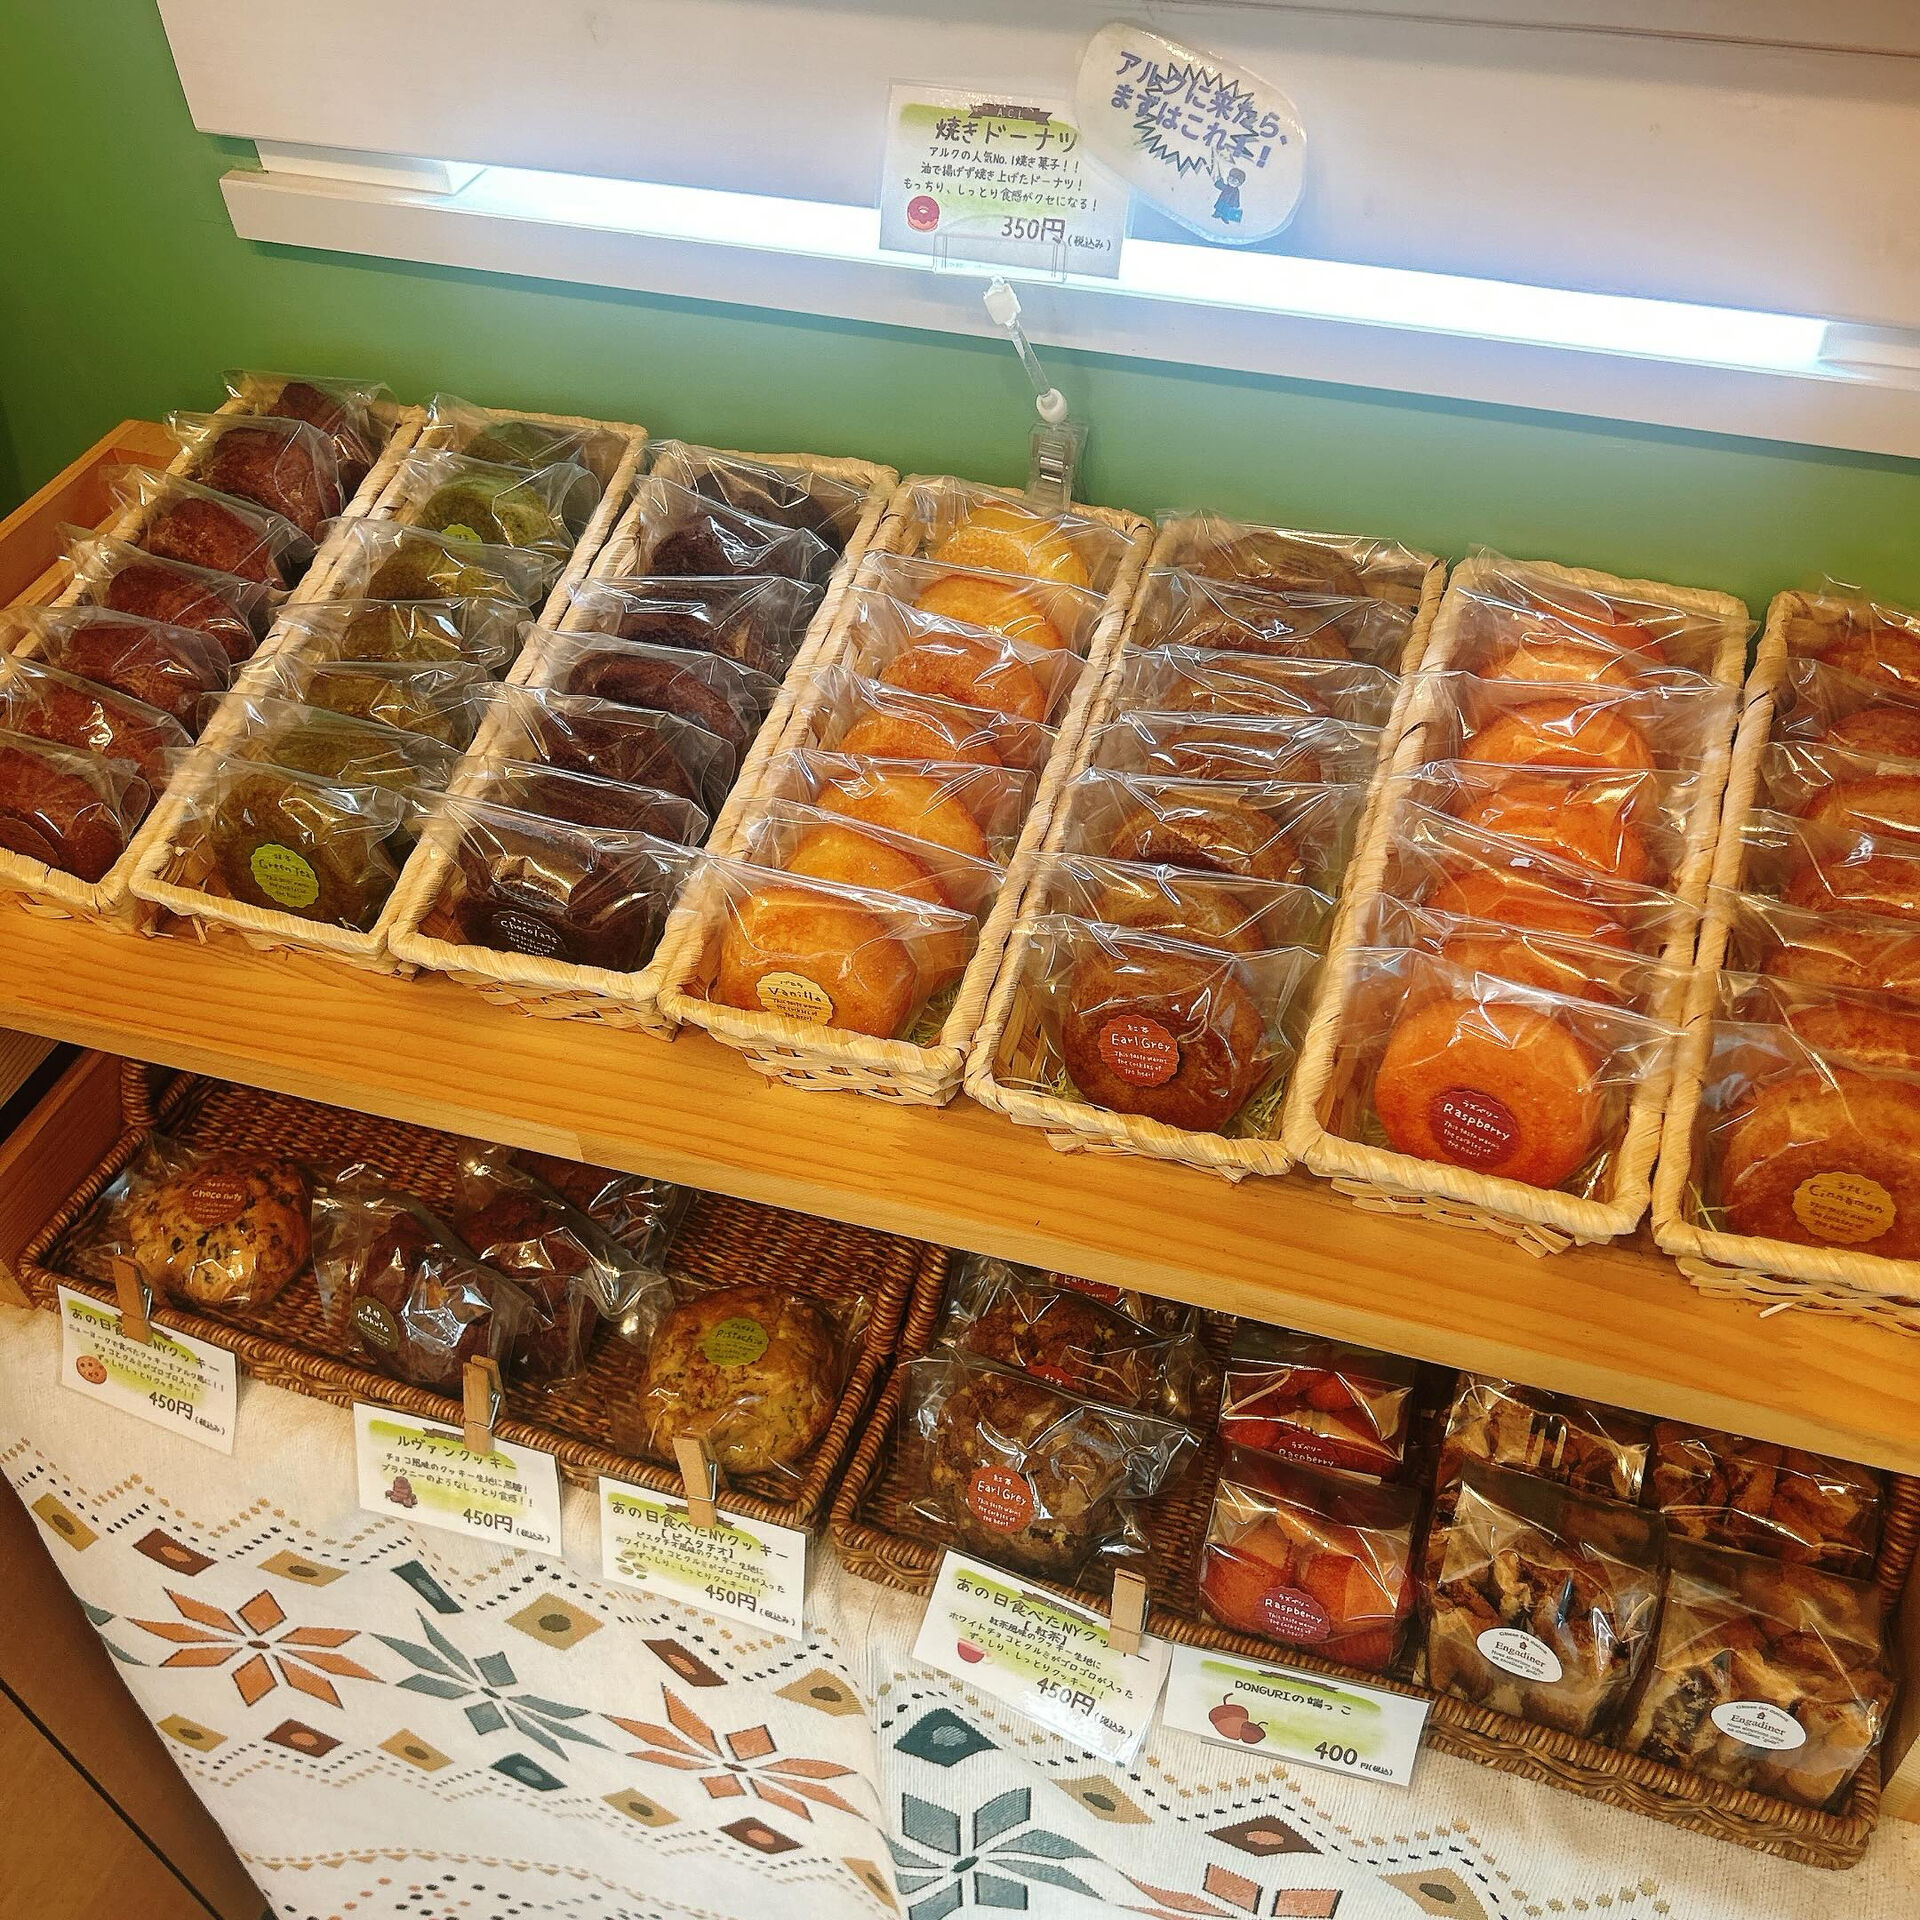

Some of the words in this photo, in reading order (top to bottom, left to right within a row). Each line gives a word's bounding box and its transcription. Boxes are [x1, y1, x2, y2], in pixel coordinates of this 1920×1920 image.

[935, 116, 1078, 153] 焼きドーナツ
[920, 163, 1083, 191] 油で揚げず焼き上げたドーナツ！
[904, 177, 1098, 212] もっちり、しっとり食感がクセになる！
[1001, 216, 1066, 244] 350円
[767, 986, 822, 1002] Vanilla
[1111, 1033, 1138, 1046] Earl
[1141, 1037, 1171, 1053] Grey
[1443, 1103, 1510, 1141] Raspberry
[1808, 1184, 1885, 1214] Cinnamon
[71, 1308, 219, 1372] あの日食NYクッキー
[148, 1391, 193, 1420] 450円
[398, 1435, 517, 1470] ルヴァンクッキー
[977, 1480, 1000, 1495] Earl
[1002, 1488, 1027, 1506] Grey
[463, 1508, 513, 1534] 450円
[704, 1584, 757, 1613] 450円
[1264, 1598, 1323, 1623] Raspberry
[956, 1577, 1150, 1663] あの日食べたNYクッー
[989, 1616, 1102, 1670] 紅茶風味のクッキー生地に
[1494, 1641, 1546, 1668] Engadiner
[1036, 1677, 1096, 1717] 450円
[1234, 1679, 1352, 1716] DONGURIの端っこ
[1730, 1714, 1786, 1736] Engadiner
[1314, 1741, 1358, 1766] 400
